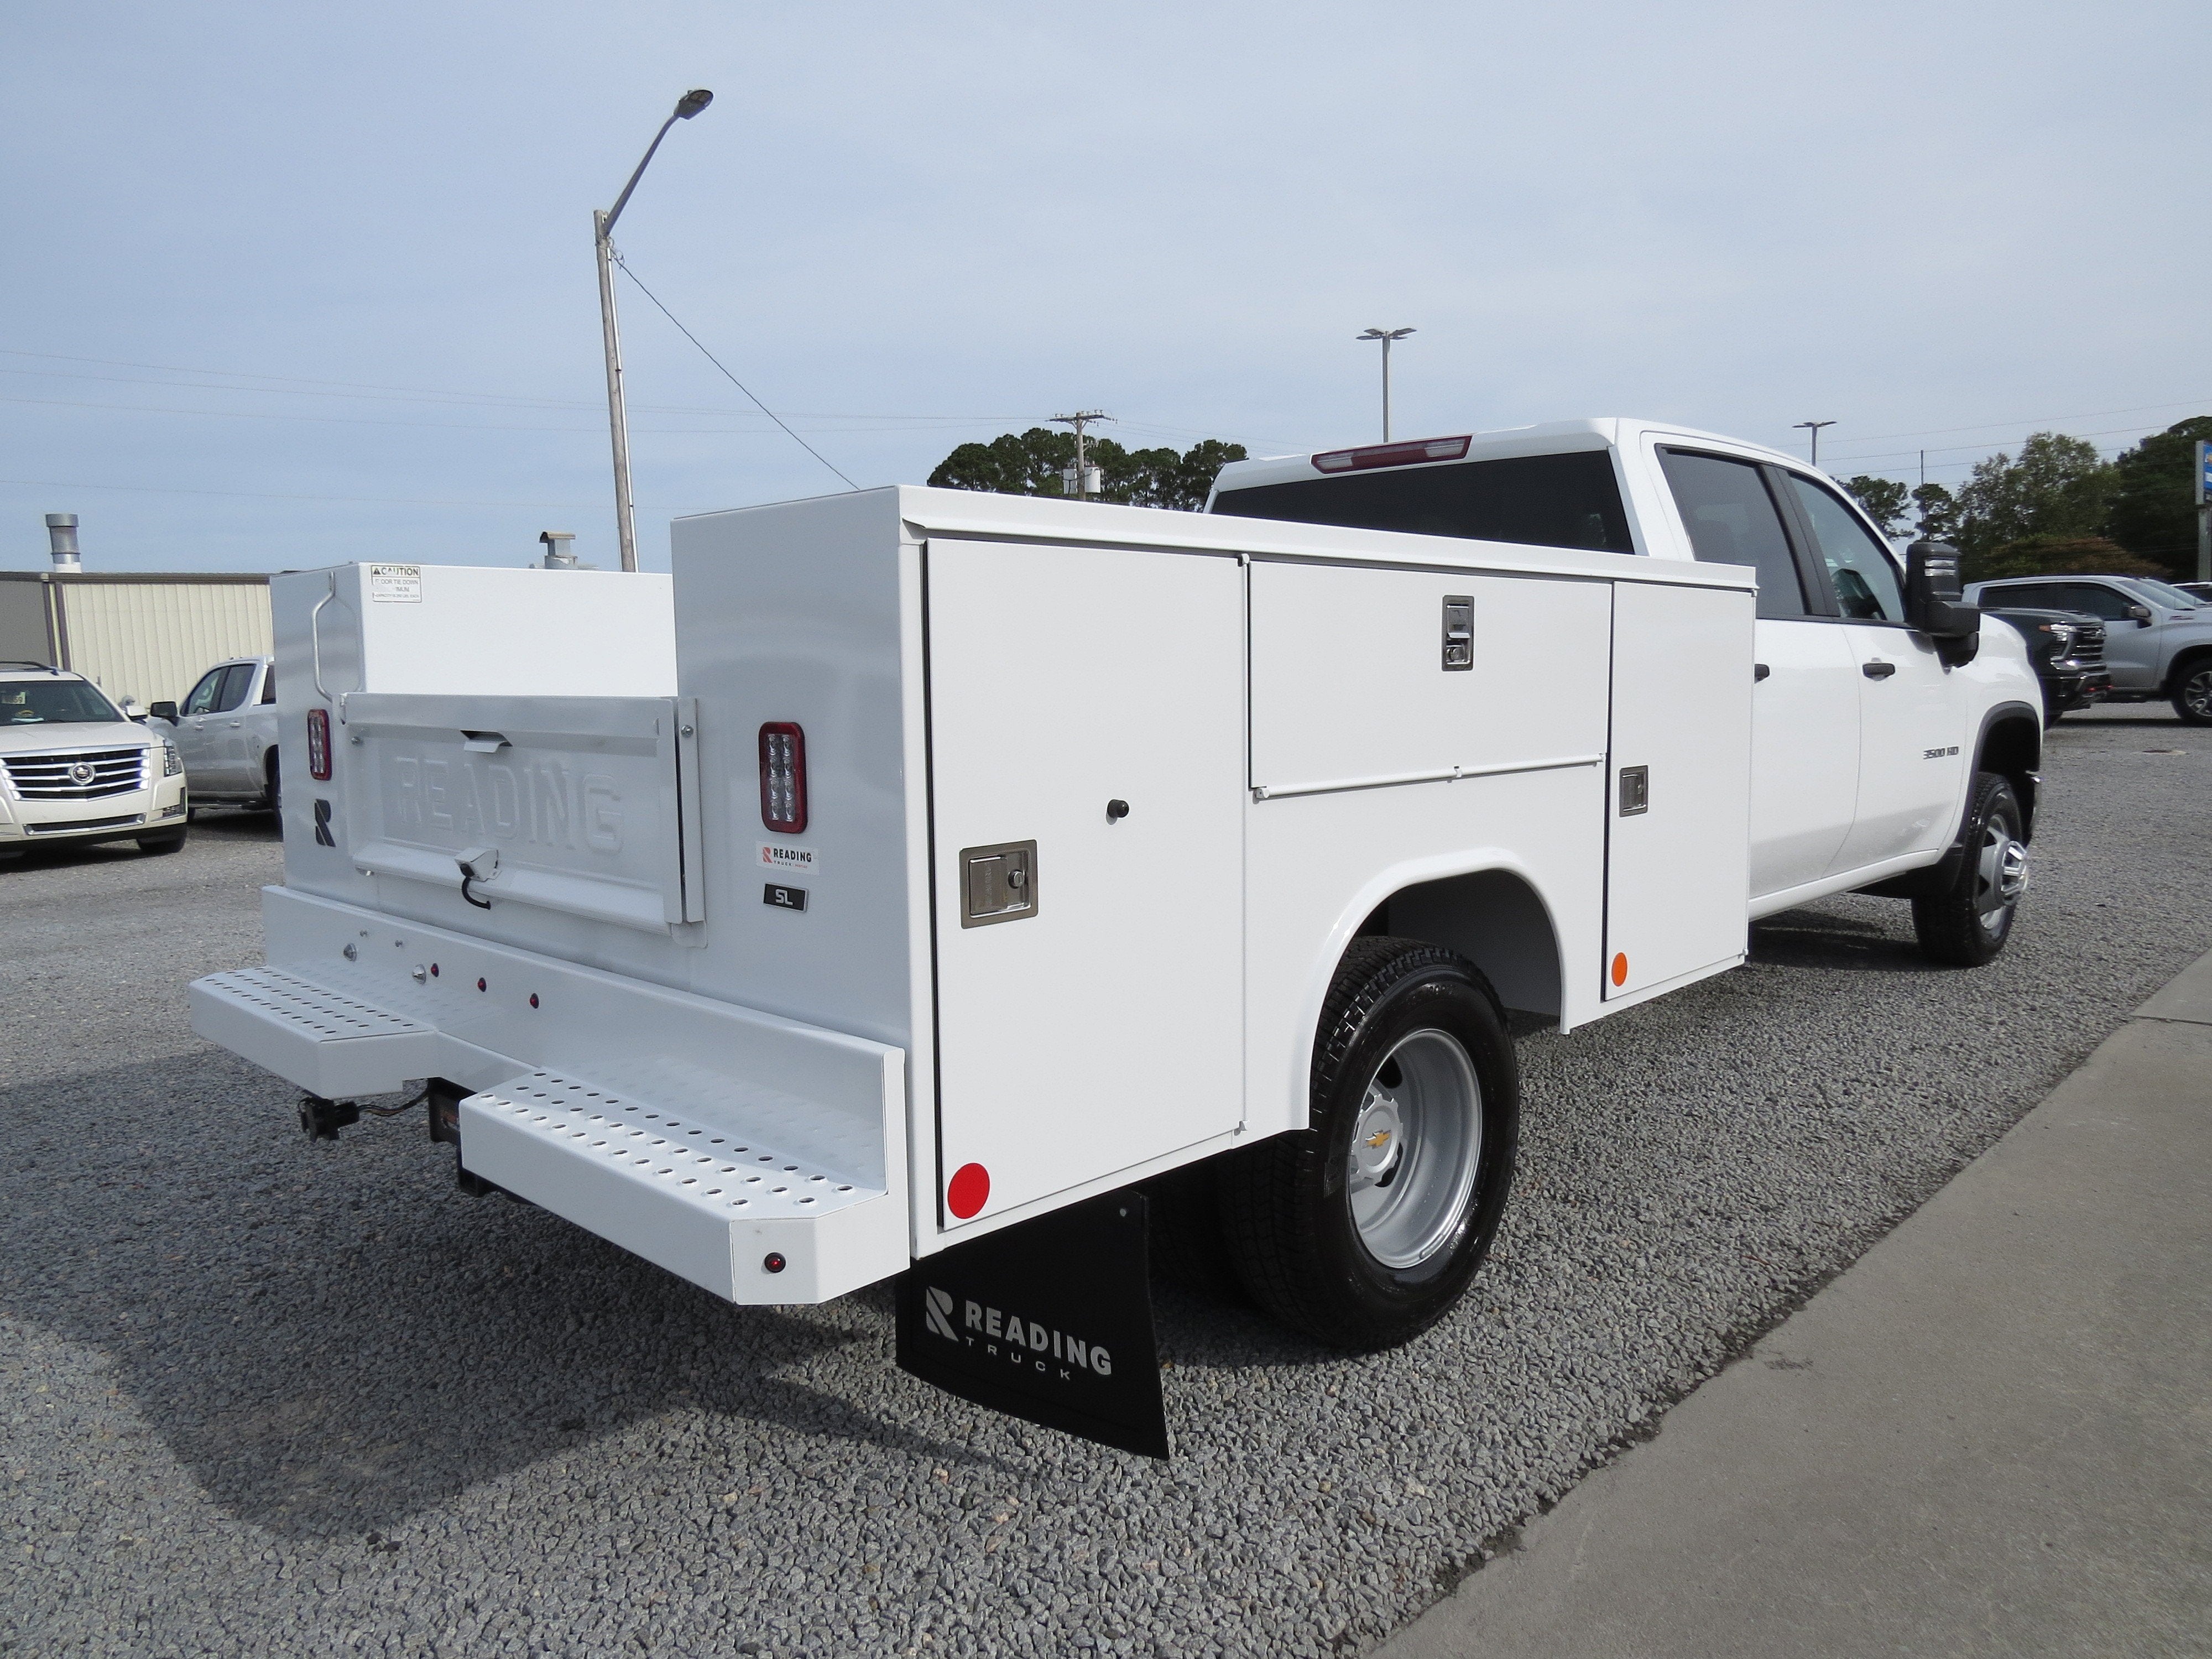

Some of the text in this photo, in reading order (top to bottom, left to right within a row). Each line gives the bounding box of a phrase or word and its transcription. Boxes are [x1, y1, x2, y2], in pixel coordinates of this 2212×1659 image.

[382, 567, 419, 576] CAUTION
[1923, 746, 1959, 760] 3500 HD
[392, 755, 624, 855] READING
[773, 848, 812, 863] READING
[775, 889, 794, 906] SL
[965, 1300, 1112, 1376] READING
[966, 1335, 1071, 1381] TRUCK
